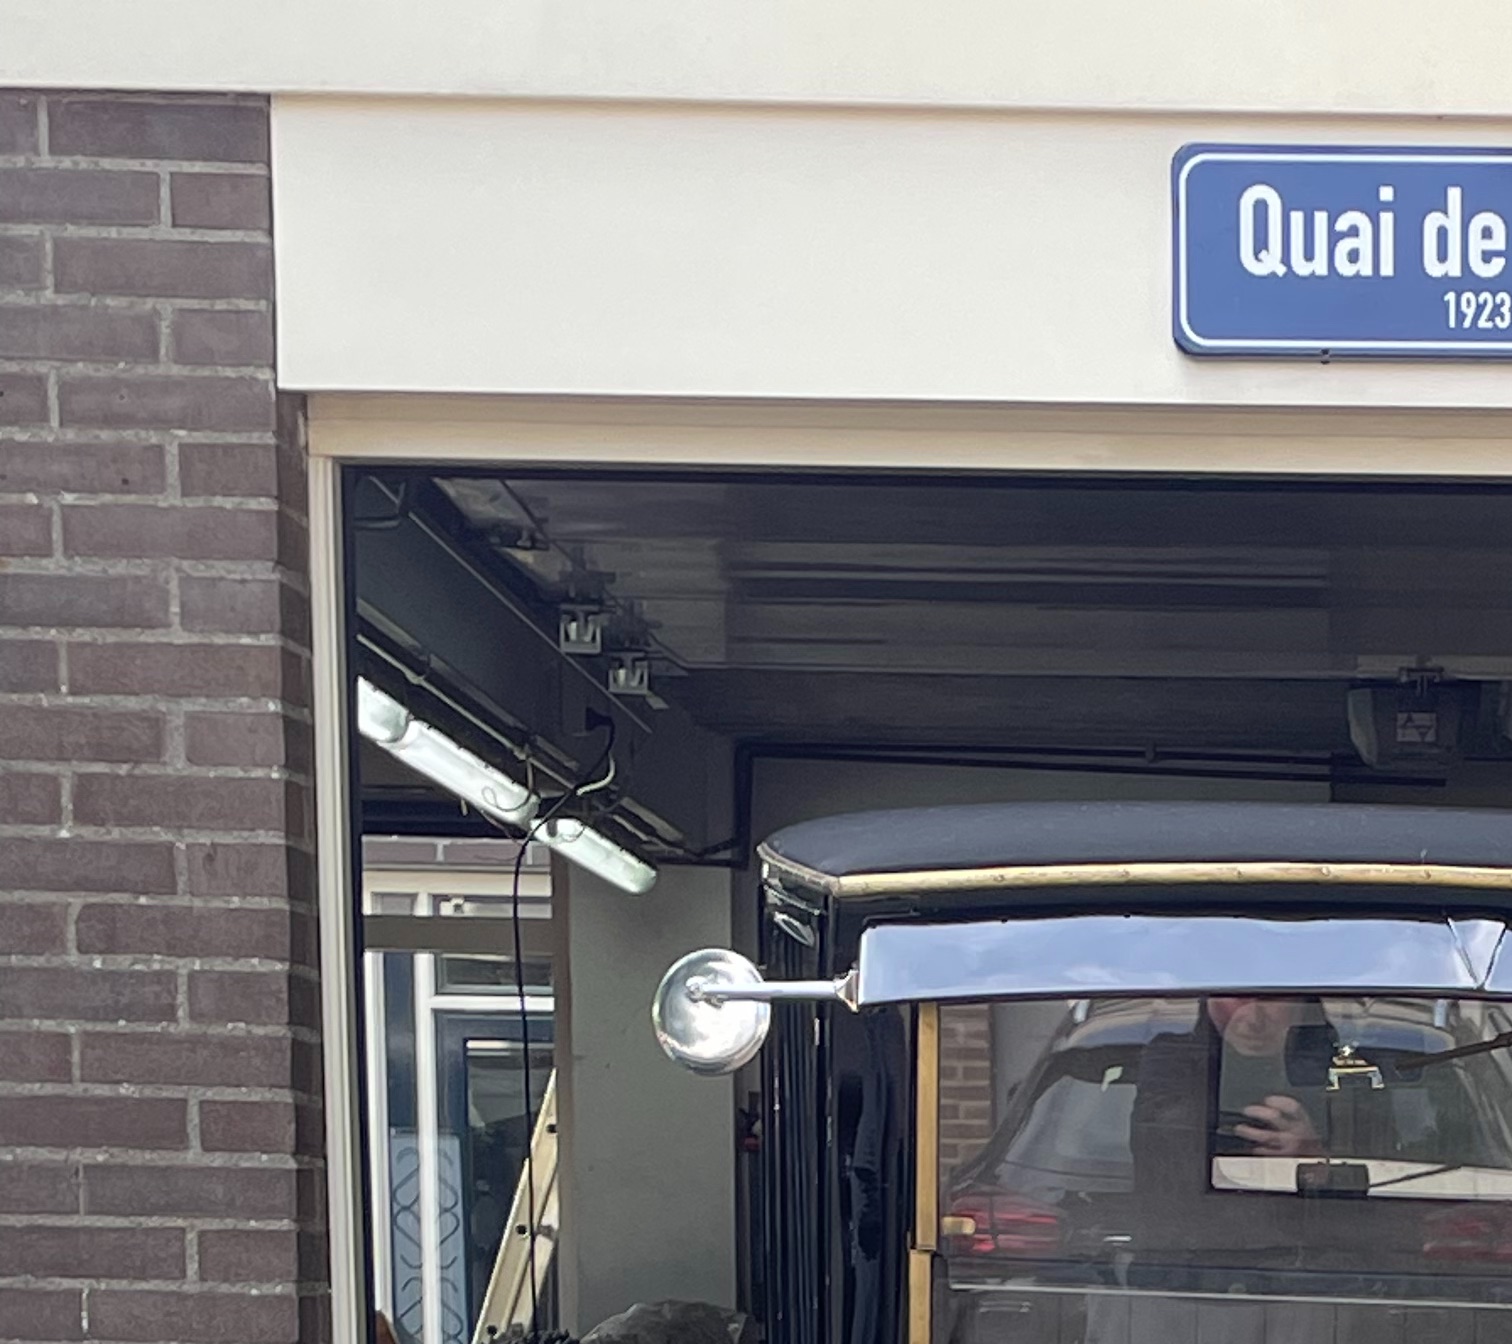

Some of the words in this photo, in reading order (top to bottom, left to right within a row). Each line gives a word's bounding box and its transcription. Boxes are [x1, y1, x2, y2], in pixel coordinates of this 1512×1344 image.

[1238, 183, 1395, 278] Quai
[1422, 186, 1507, 278] de
[1443, 290, 1512, 330] 1923
